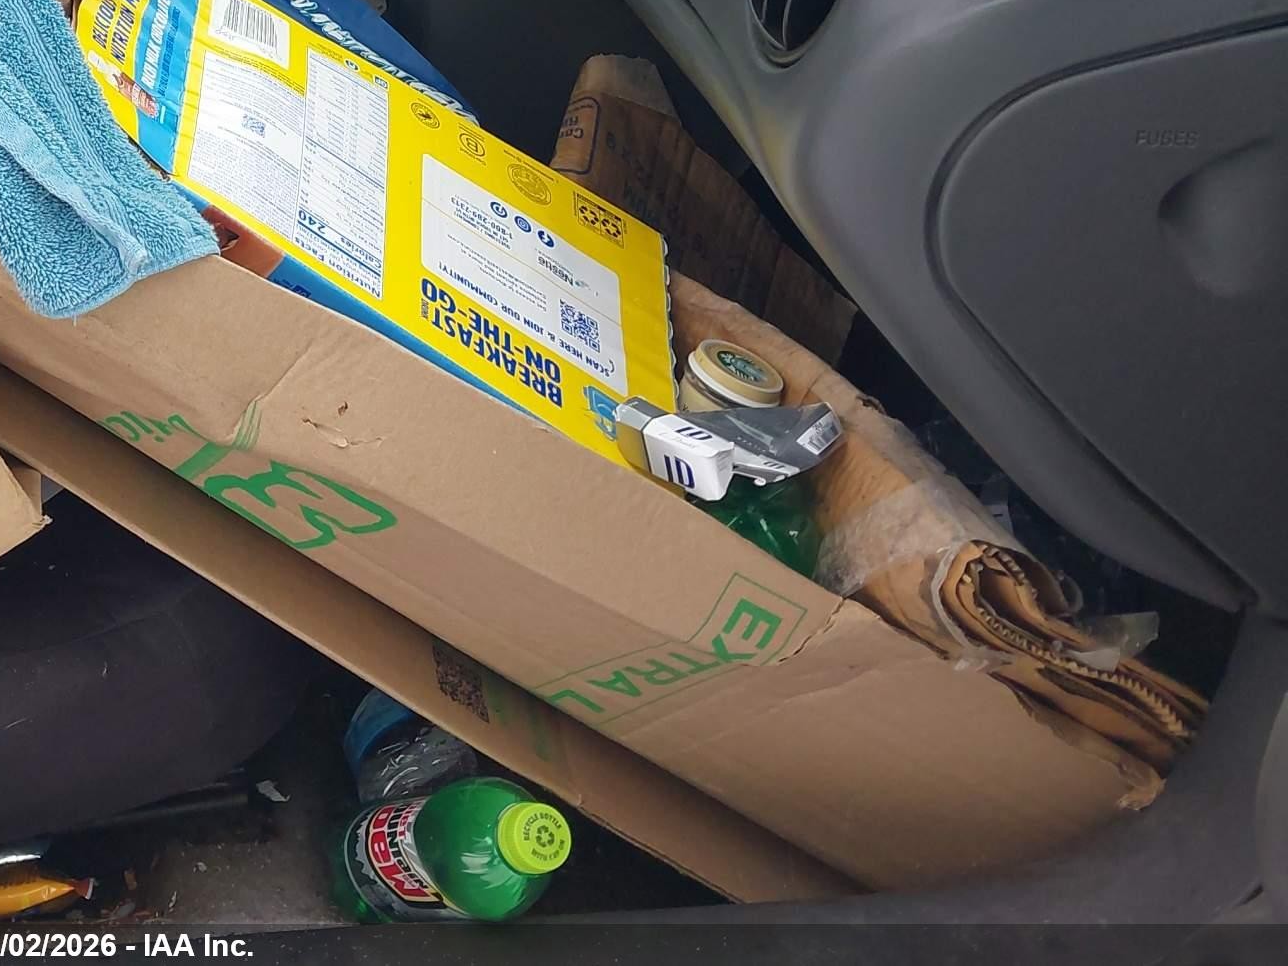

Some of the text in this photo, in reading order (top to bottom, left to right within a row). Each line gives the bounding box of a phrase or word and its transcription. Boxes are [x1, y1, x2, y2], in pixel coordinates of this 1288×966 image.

[110, 6, 135, 65] NUTRITION
[1135, 129, 1200, 147] FUSES
[294, 236, 324, 262] Facts
[297, 208, 381, 270] Calories 240
[328, 257, 380, 299] Nutrition
[418, 276, 560, 385] ON-THE-GO
[438, 259, 609, 378] SCAN HERE & JOIN OUR COMMUNITY!
[430, 306, 561, 408] BREAKFAST
[588, 597, 782, 698] EXTRA
[523, 812, 562, 841] RECYCLE BOTTLE
